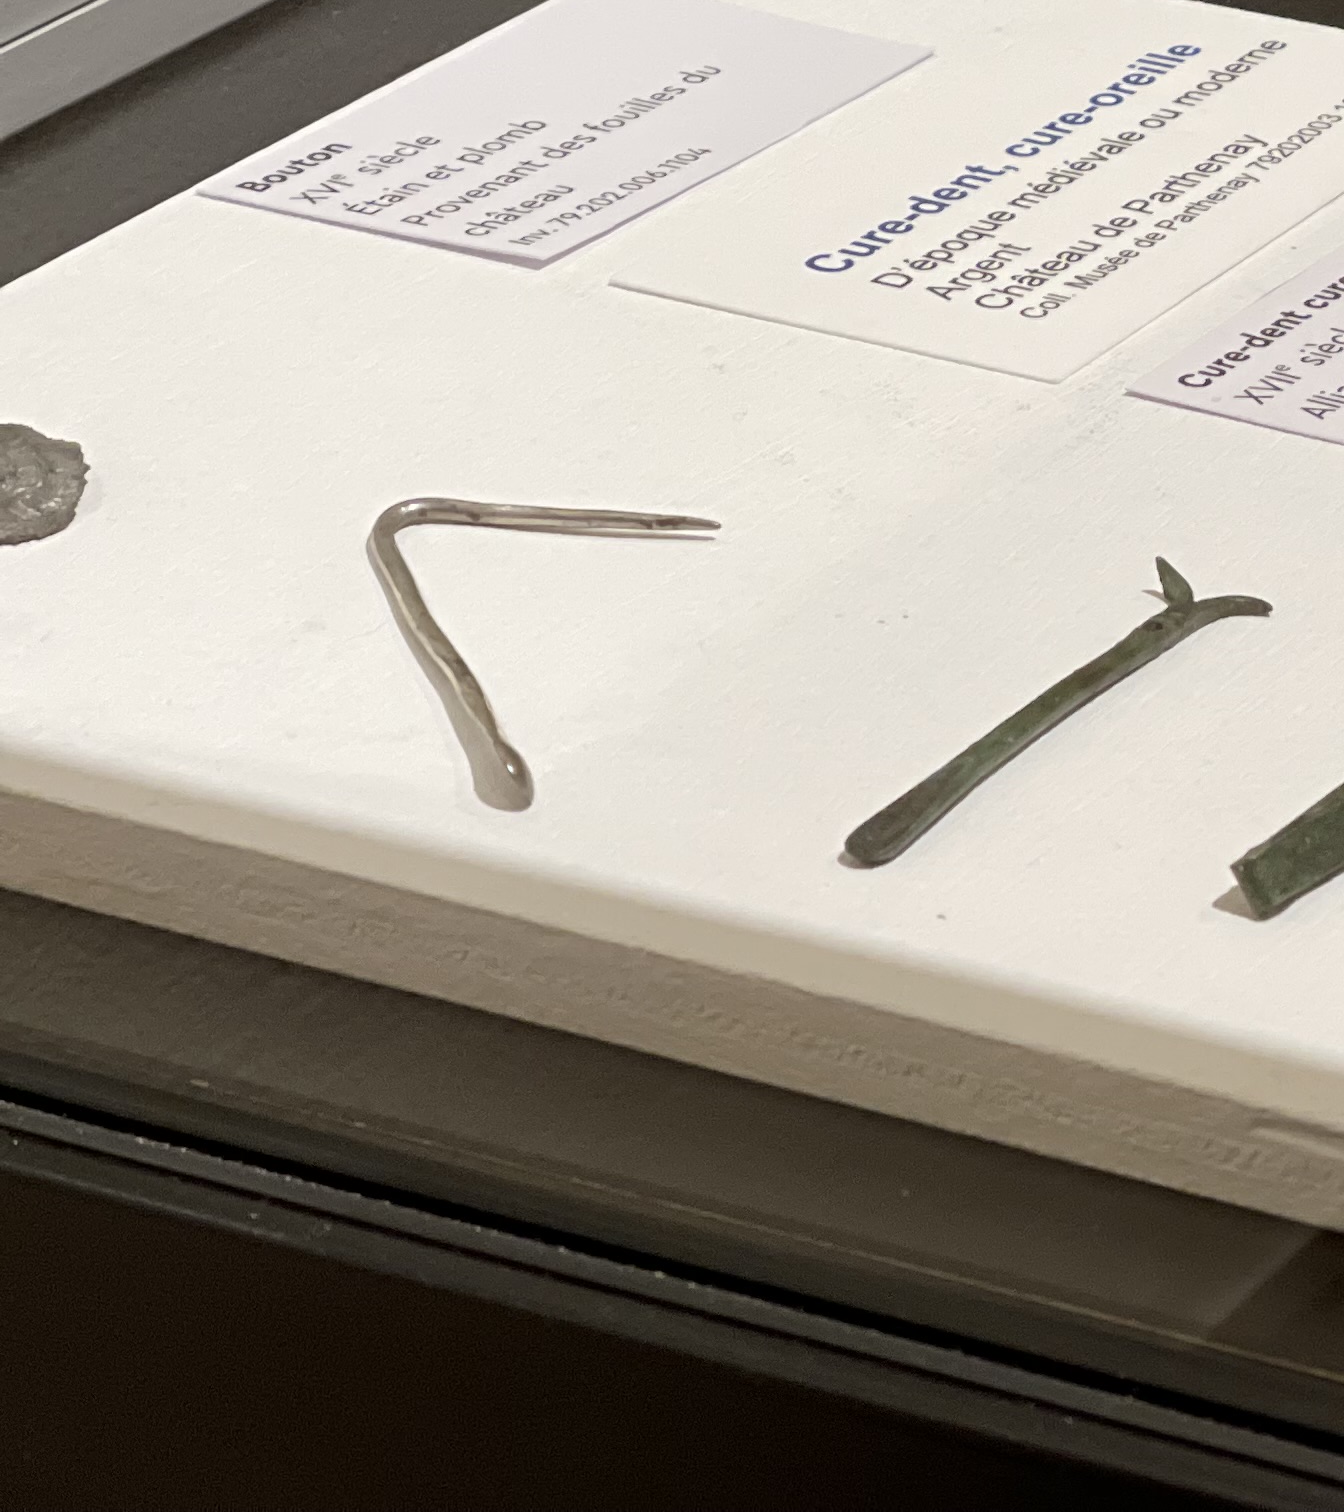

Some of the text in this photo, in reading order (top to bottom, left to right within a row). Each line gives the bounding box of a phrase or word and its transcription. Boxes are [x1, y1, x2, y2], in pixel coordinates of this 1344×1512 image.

[234, 142, 352, 193] Bouton
[341, 119, 547, 215] Étain et plomb
[356, 135, 441, 175] siècle
[399, 64, 721, 226] Provenant des fouilles du
[804, 44, 1201, 273] Cure-dent, cure-oreille
[869, 39, 1287, 289] D'époque médiévale ou moderne
[463, 184, 574, 236] château
[507, 228, 559, 246] Inv.
[974, 133, 1269, 309] Château de Parthenay
[1018, 292, 1071, 319] Coll.
[1062, 249, 1140, 290] Musée
[1133, 231, 1167, 248] de
[1153, 172, 1260, 231] Parthenay
[925, 242, 1032, 301] Argent
[1177, 310, 1313, 388] Cure-dent
